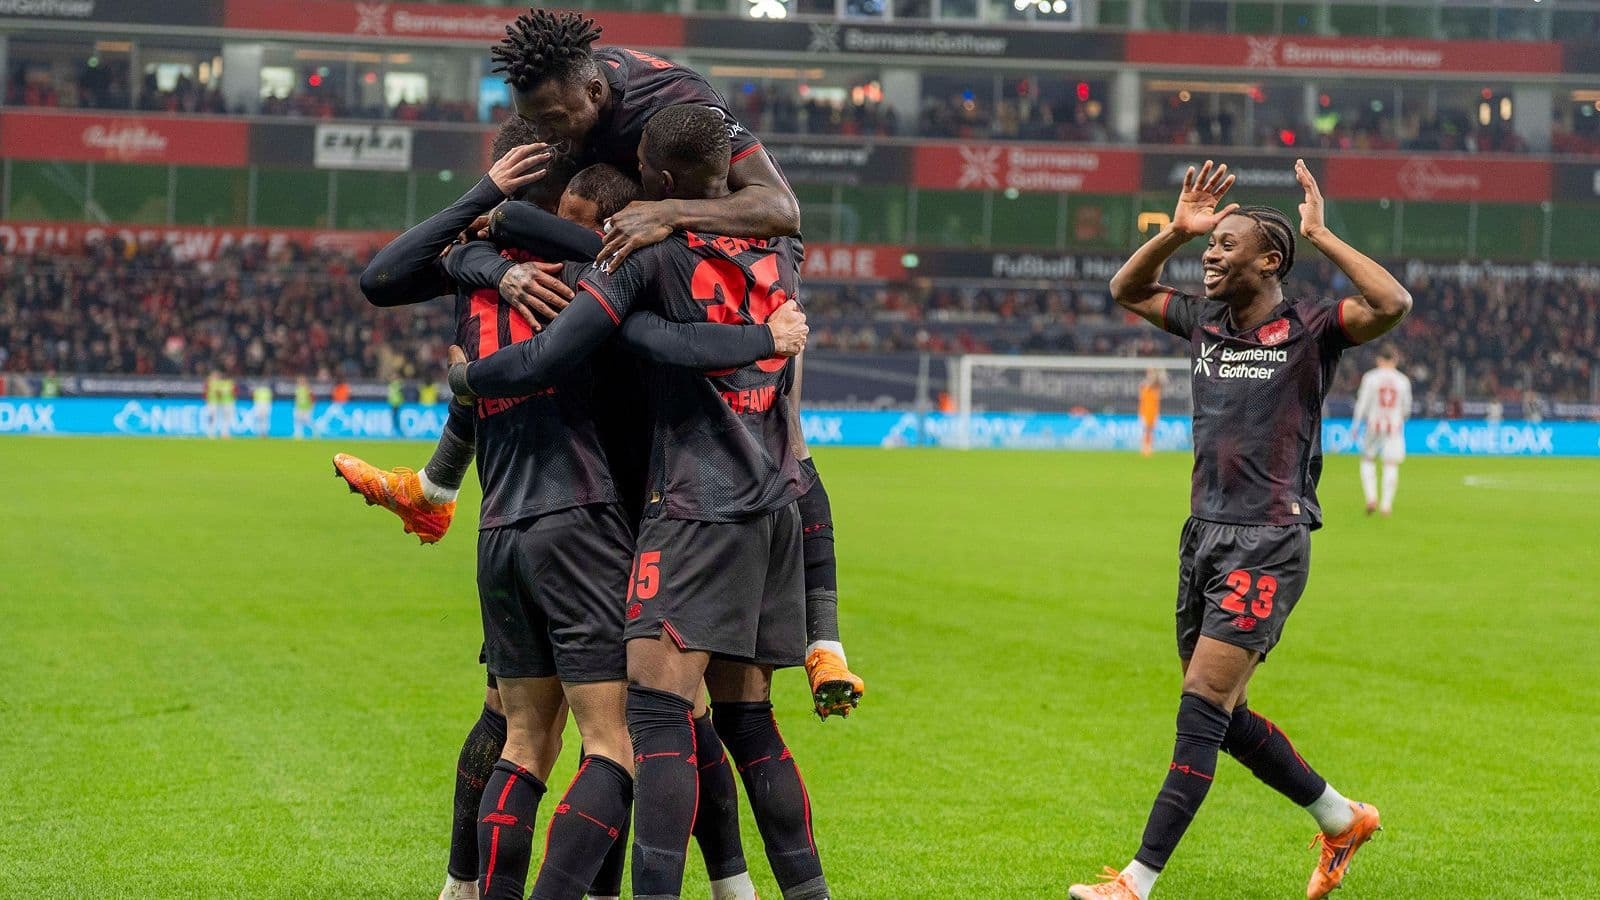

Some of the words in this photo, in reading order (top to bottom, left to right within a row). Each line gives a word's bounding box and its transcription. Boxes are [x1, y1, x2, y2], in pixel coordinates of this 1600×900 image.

[1220, 347, 1288, 363] Barmenia
[1219, 363, 1275, 380] Gothaer
[719, 385, 777, 415] OFANE
[1457, 424, 1553, 454] NIEDAX
[1220, 569, 1278, 619] 23
